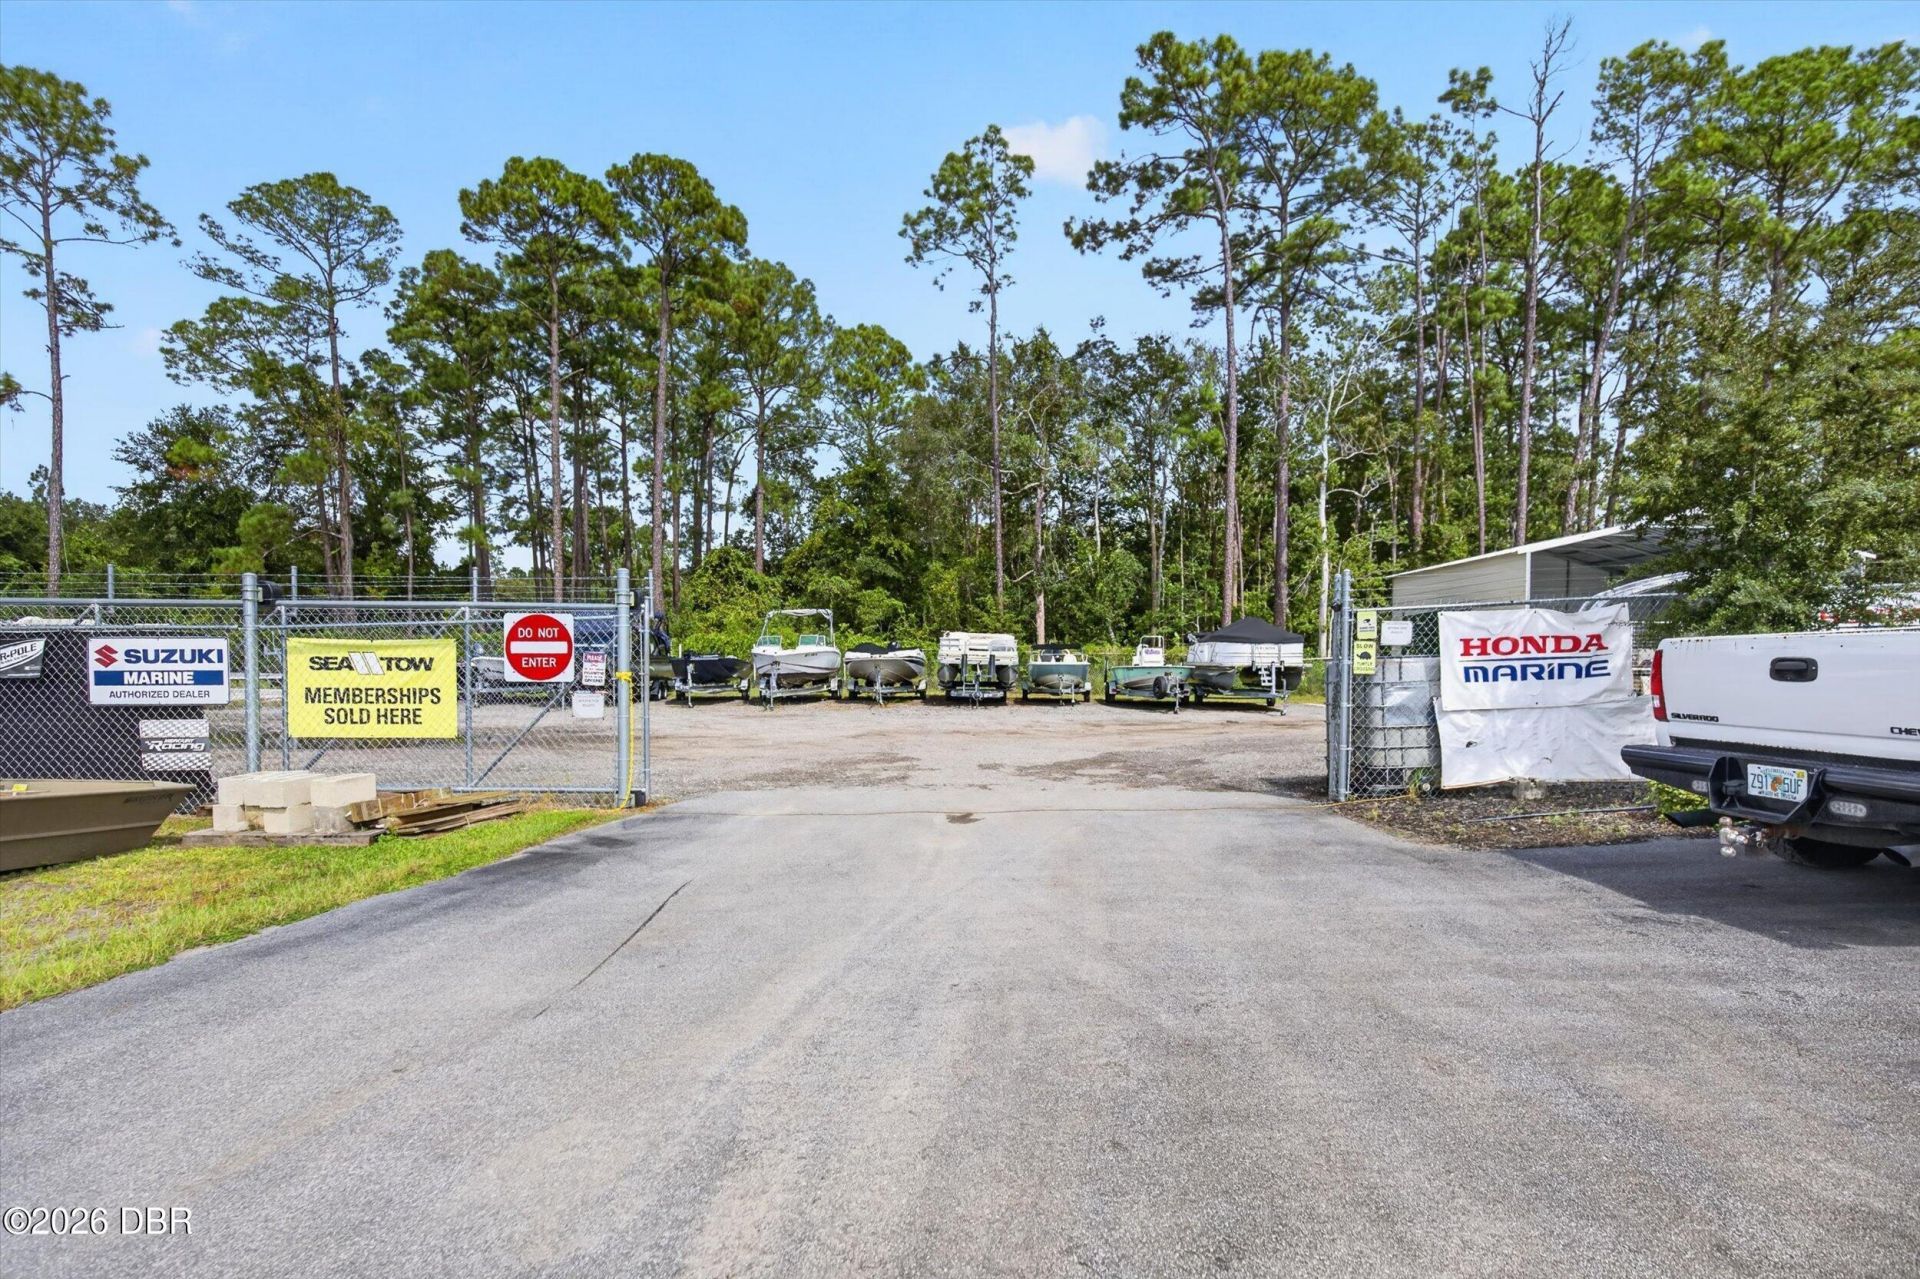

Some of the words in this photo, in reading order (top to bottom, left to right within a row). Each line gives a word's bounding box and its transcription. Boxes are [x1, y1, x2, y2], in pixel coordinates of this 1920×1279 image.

[518, 627, 533, 638] DO
[538, 627, 559, 638] NOT
[1460, 634, 1608, 656] HONDA
[124, 649, 223, 664] SUZUKI
[309, 656, 354, 671] SEA
[380, 657, 434, 671] TOW
[521, 657, 557, 668] ENTER
[123, 671, 194, 685] MARINE
[1463, 660, 1611, 683] MARINE
[109, 690, 169, 699] AUTHORIZED
[173, 690, 210, 698] DEALER
[304, 687, 441, 704] MEMBERSHIPS
[324, 707, 370, 725] SOLD
[376, 708, 423, 725] HERE
[1671, 712, 1719, 722] SILVERADO
[145, 740, 205, 752] Racing
[1750, 773, 1768, 790] Z91
